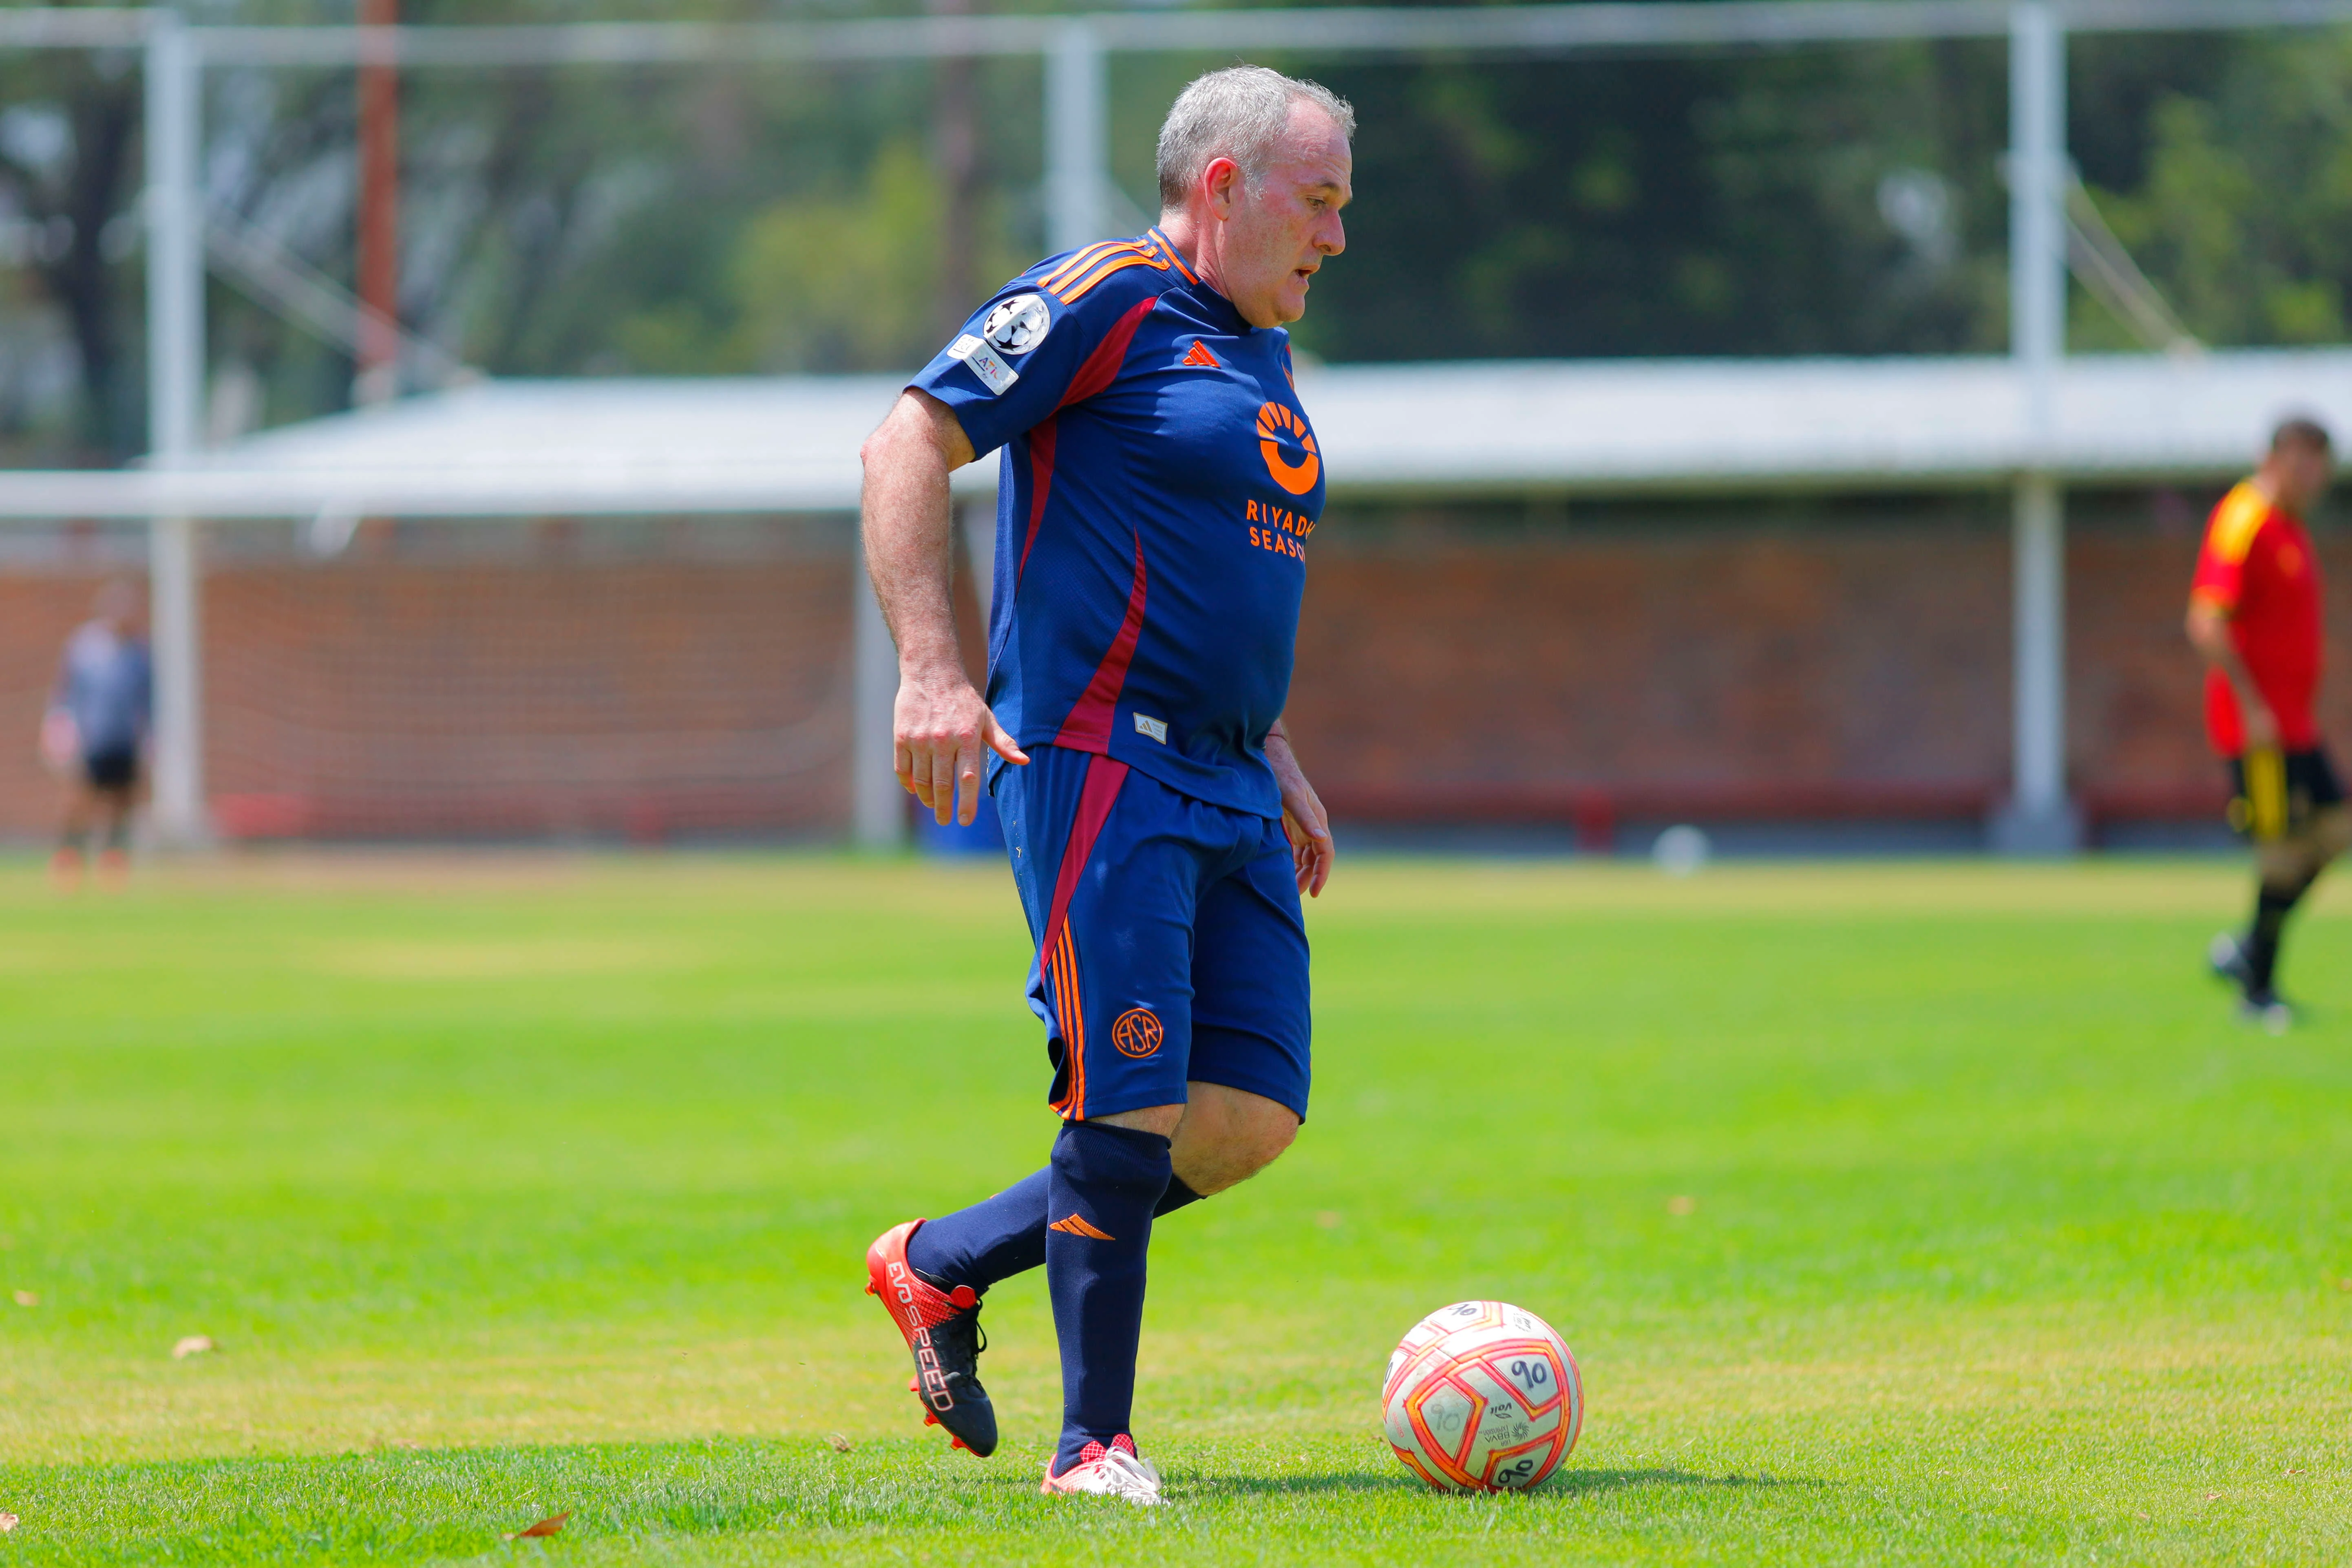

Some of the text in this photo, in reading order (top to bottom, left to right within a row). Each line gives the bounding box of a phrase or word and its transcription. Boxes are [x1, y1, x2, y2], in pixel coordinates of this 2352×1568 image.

[1246, 499, 1316, 540] RIYADH
[1117, 1014, 1158, 1052] ASR
[888, 1261, 954, 1411] EVOSPEED
[1511, 1360, 1547, 1389] 90
[1491, 1402, 1512, 1414] Voit
[1484, 1431, 1510, 1443] BBVA
[1498, 1459, 1533, 1484] 90
